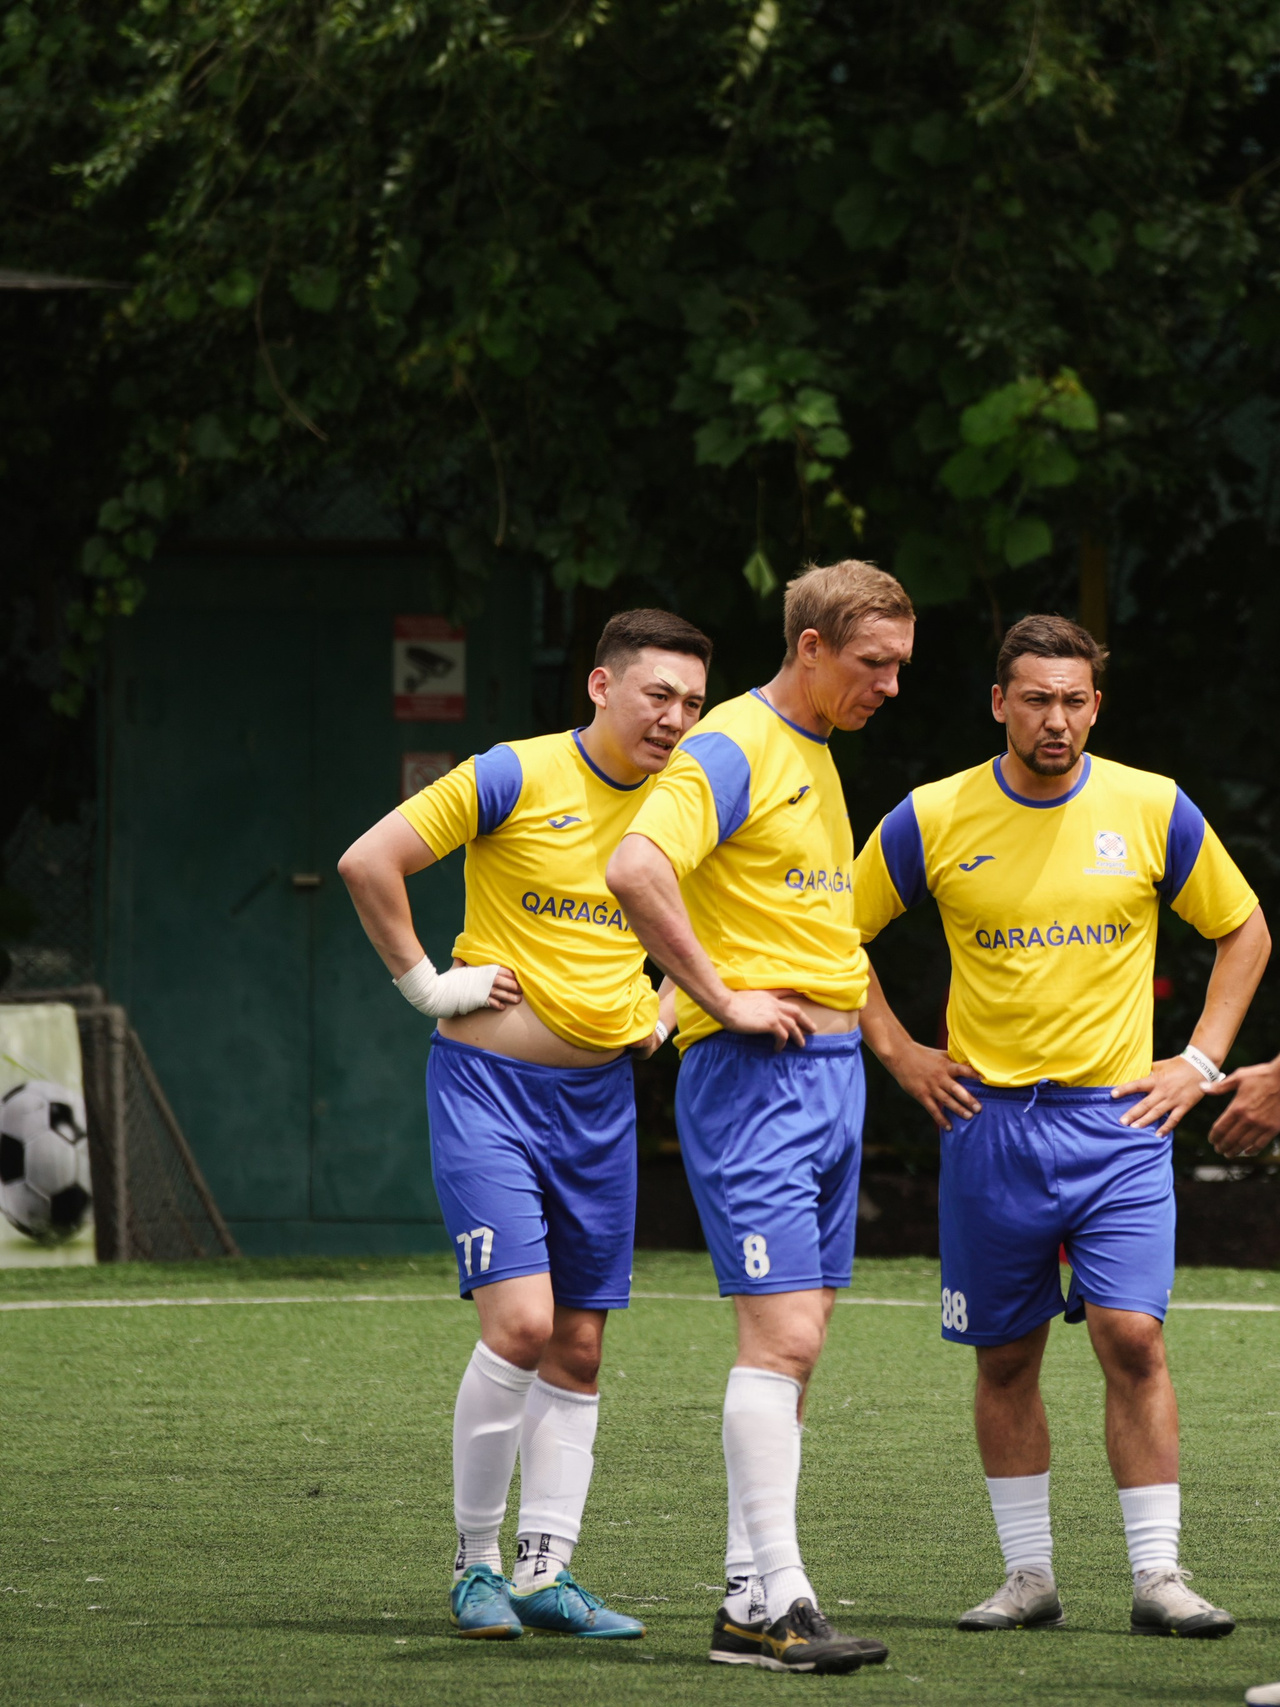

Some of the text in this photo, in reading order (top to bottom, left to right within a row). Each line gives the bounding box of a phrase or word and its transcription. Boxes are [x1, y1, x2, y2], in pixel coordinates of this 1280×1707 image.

[456, 1226, 494, 1276] 77
[743, 1234, 770, 1279] 8
[942, 1287, 968, 1333] 88
